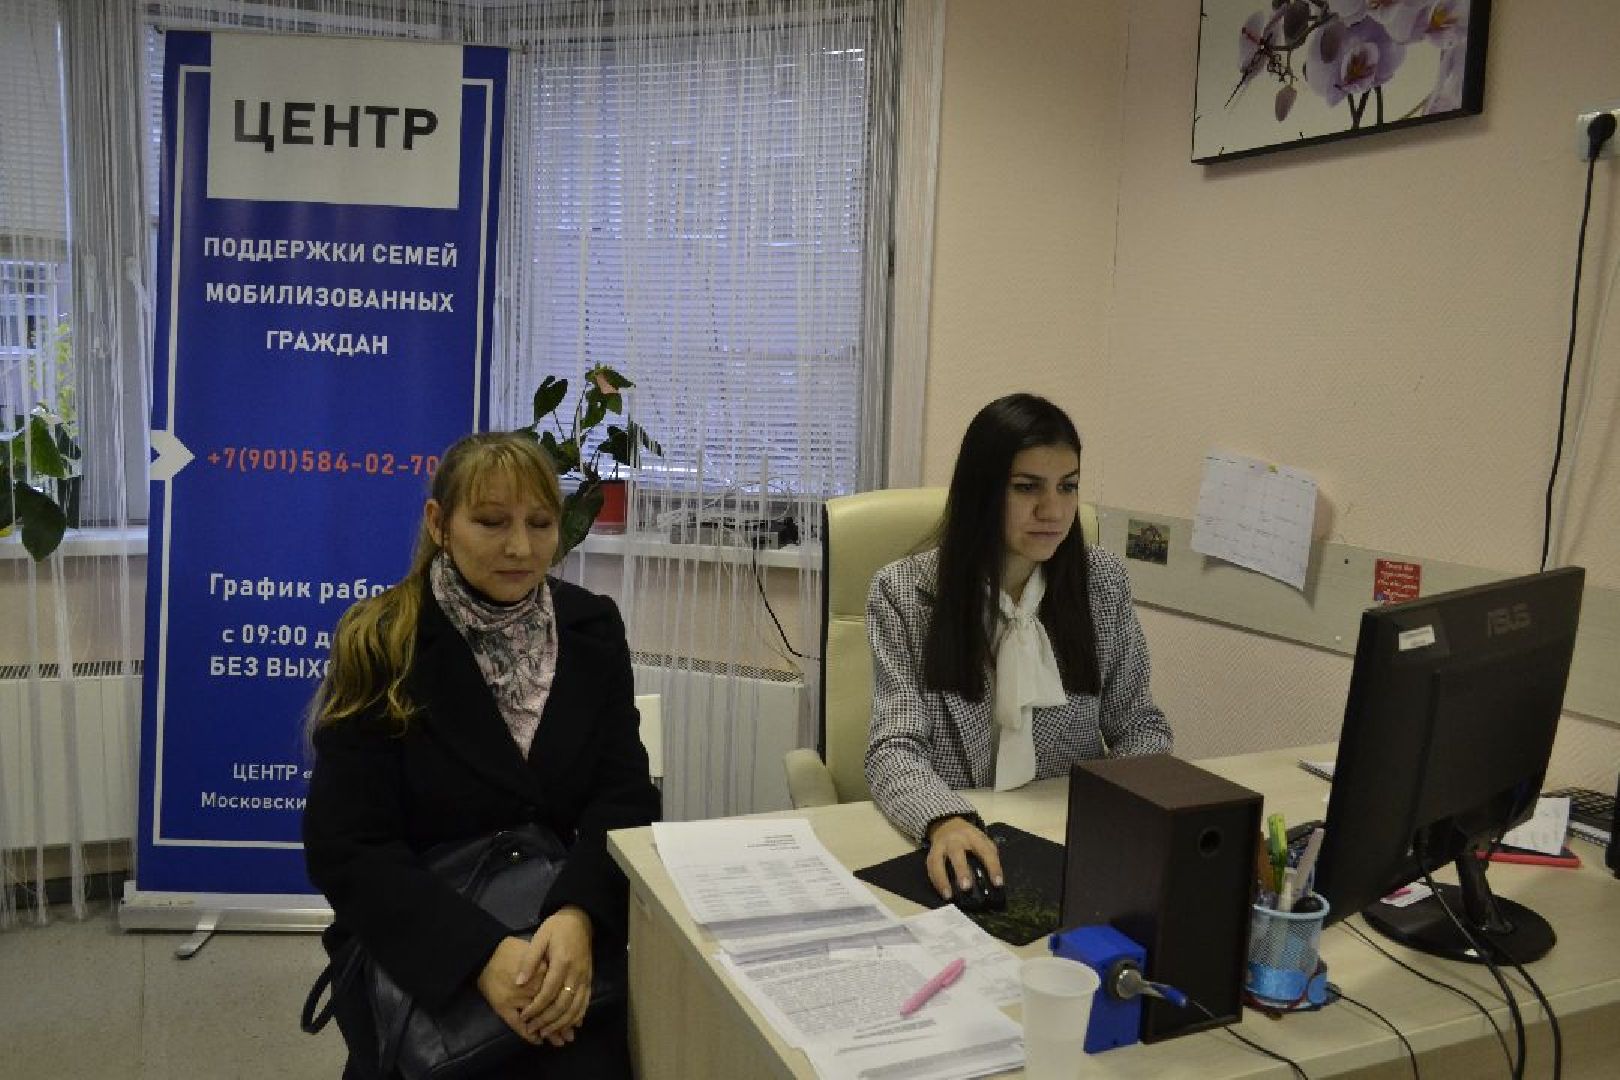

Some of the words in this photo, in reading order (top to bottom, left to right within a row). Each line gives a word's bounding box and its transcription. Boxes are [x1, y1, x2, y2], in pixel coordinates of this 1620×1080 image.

[234, 99, 439, 154] ЦЕНТР
[204, 236, 365, 263] ПОДДЕРЖКИ
[372, 242, 458, 268] СЕМЕЙ
[206, 282, 455, 313] МОБИЛИЗОВАННЫХ
[266, 330, 389, 357] ГРАЖДАН
[207, 447, 437, 475] +7(901)584-02-70
[210, 572, 311, 601] График
[222, 628, 235, 643] с
[242, 623, 307, 646] 09:00
[210, 656, 259, 676] БЕЗ
[233, 762, 298, 782] ЦЕНТР
